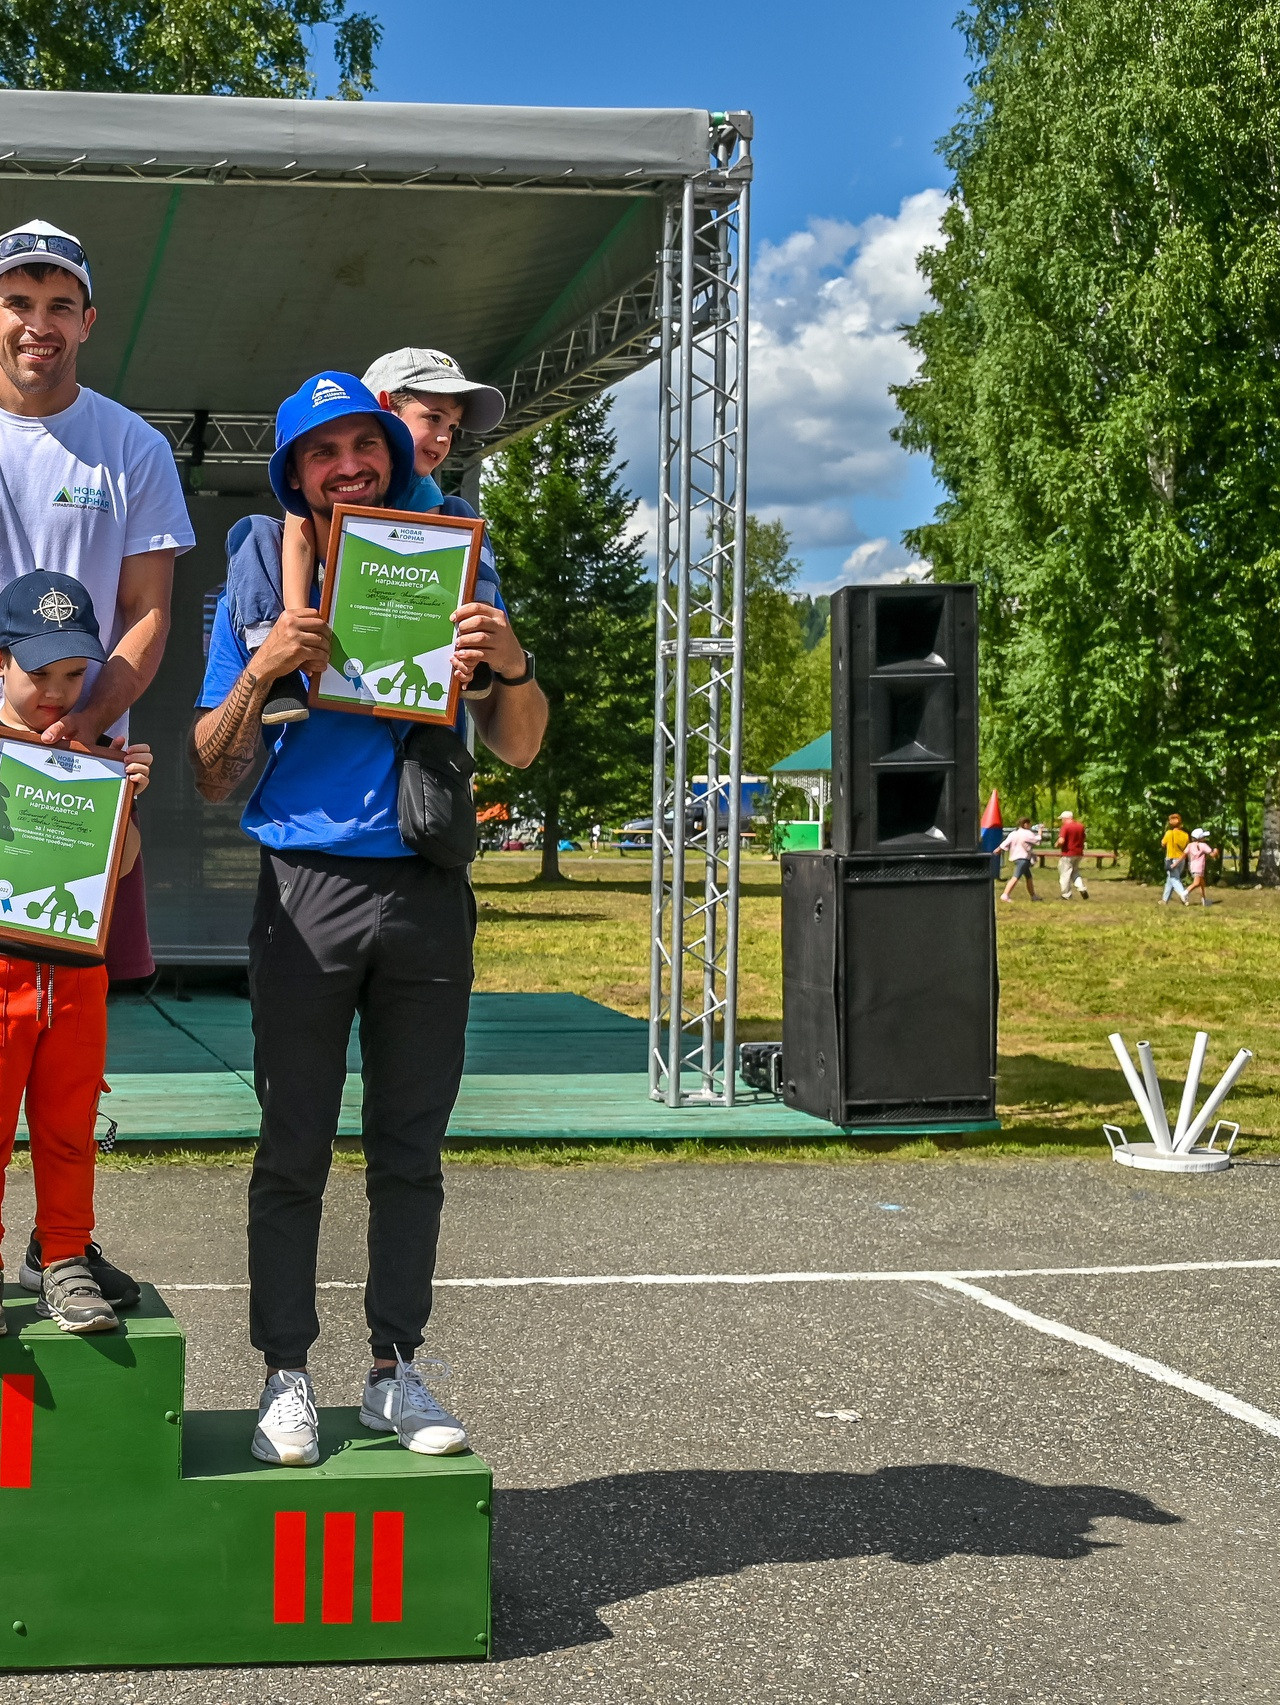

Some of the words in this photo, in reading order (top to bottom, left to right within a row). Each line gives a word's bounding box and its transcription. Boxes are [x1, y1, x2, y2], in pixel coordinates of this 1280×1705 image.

[74, 487, 107, 498] НОВАЯ
[74, 496, 110, 509] ГОРНАЯ
[400, 528, 423, 536] НОВАЯ
[400, 534, 425, 542] ГОРНАЯ
[360, 561, 440, 584] ГРАМОТА
[375, 578, 424, 589] награждается
[57, 755, 80, 764] НОВАЯ
[57, 761, 82, 770] ГОРНАЯ
[15, 784, 95, 813] ГРАМОТА
[30, 801, 79, 816] награждается
[46, 827, 65, 836] место
[272, 1510, 404, 1625] III
